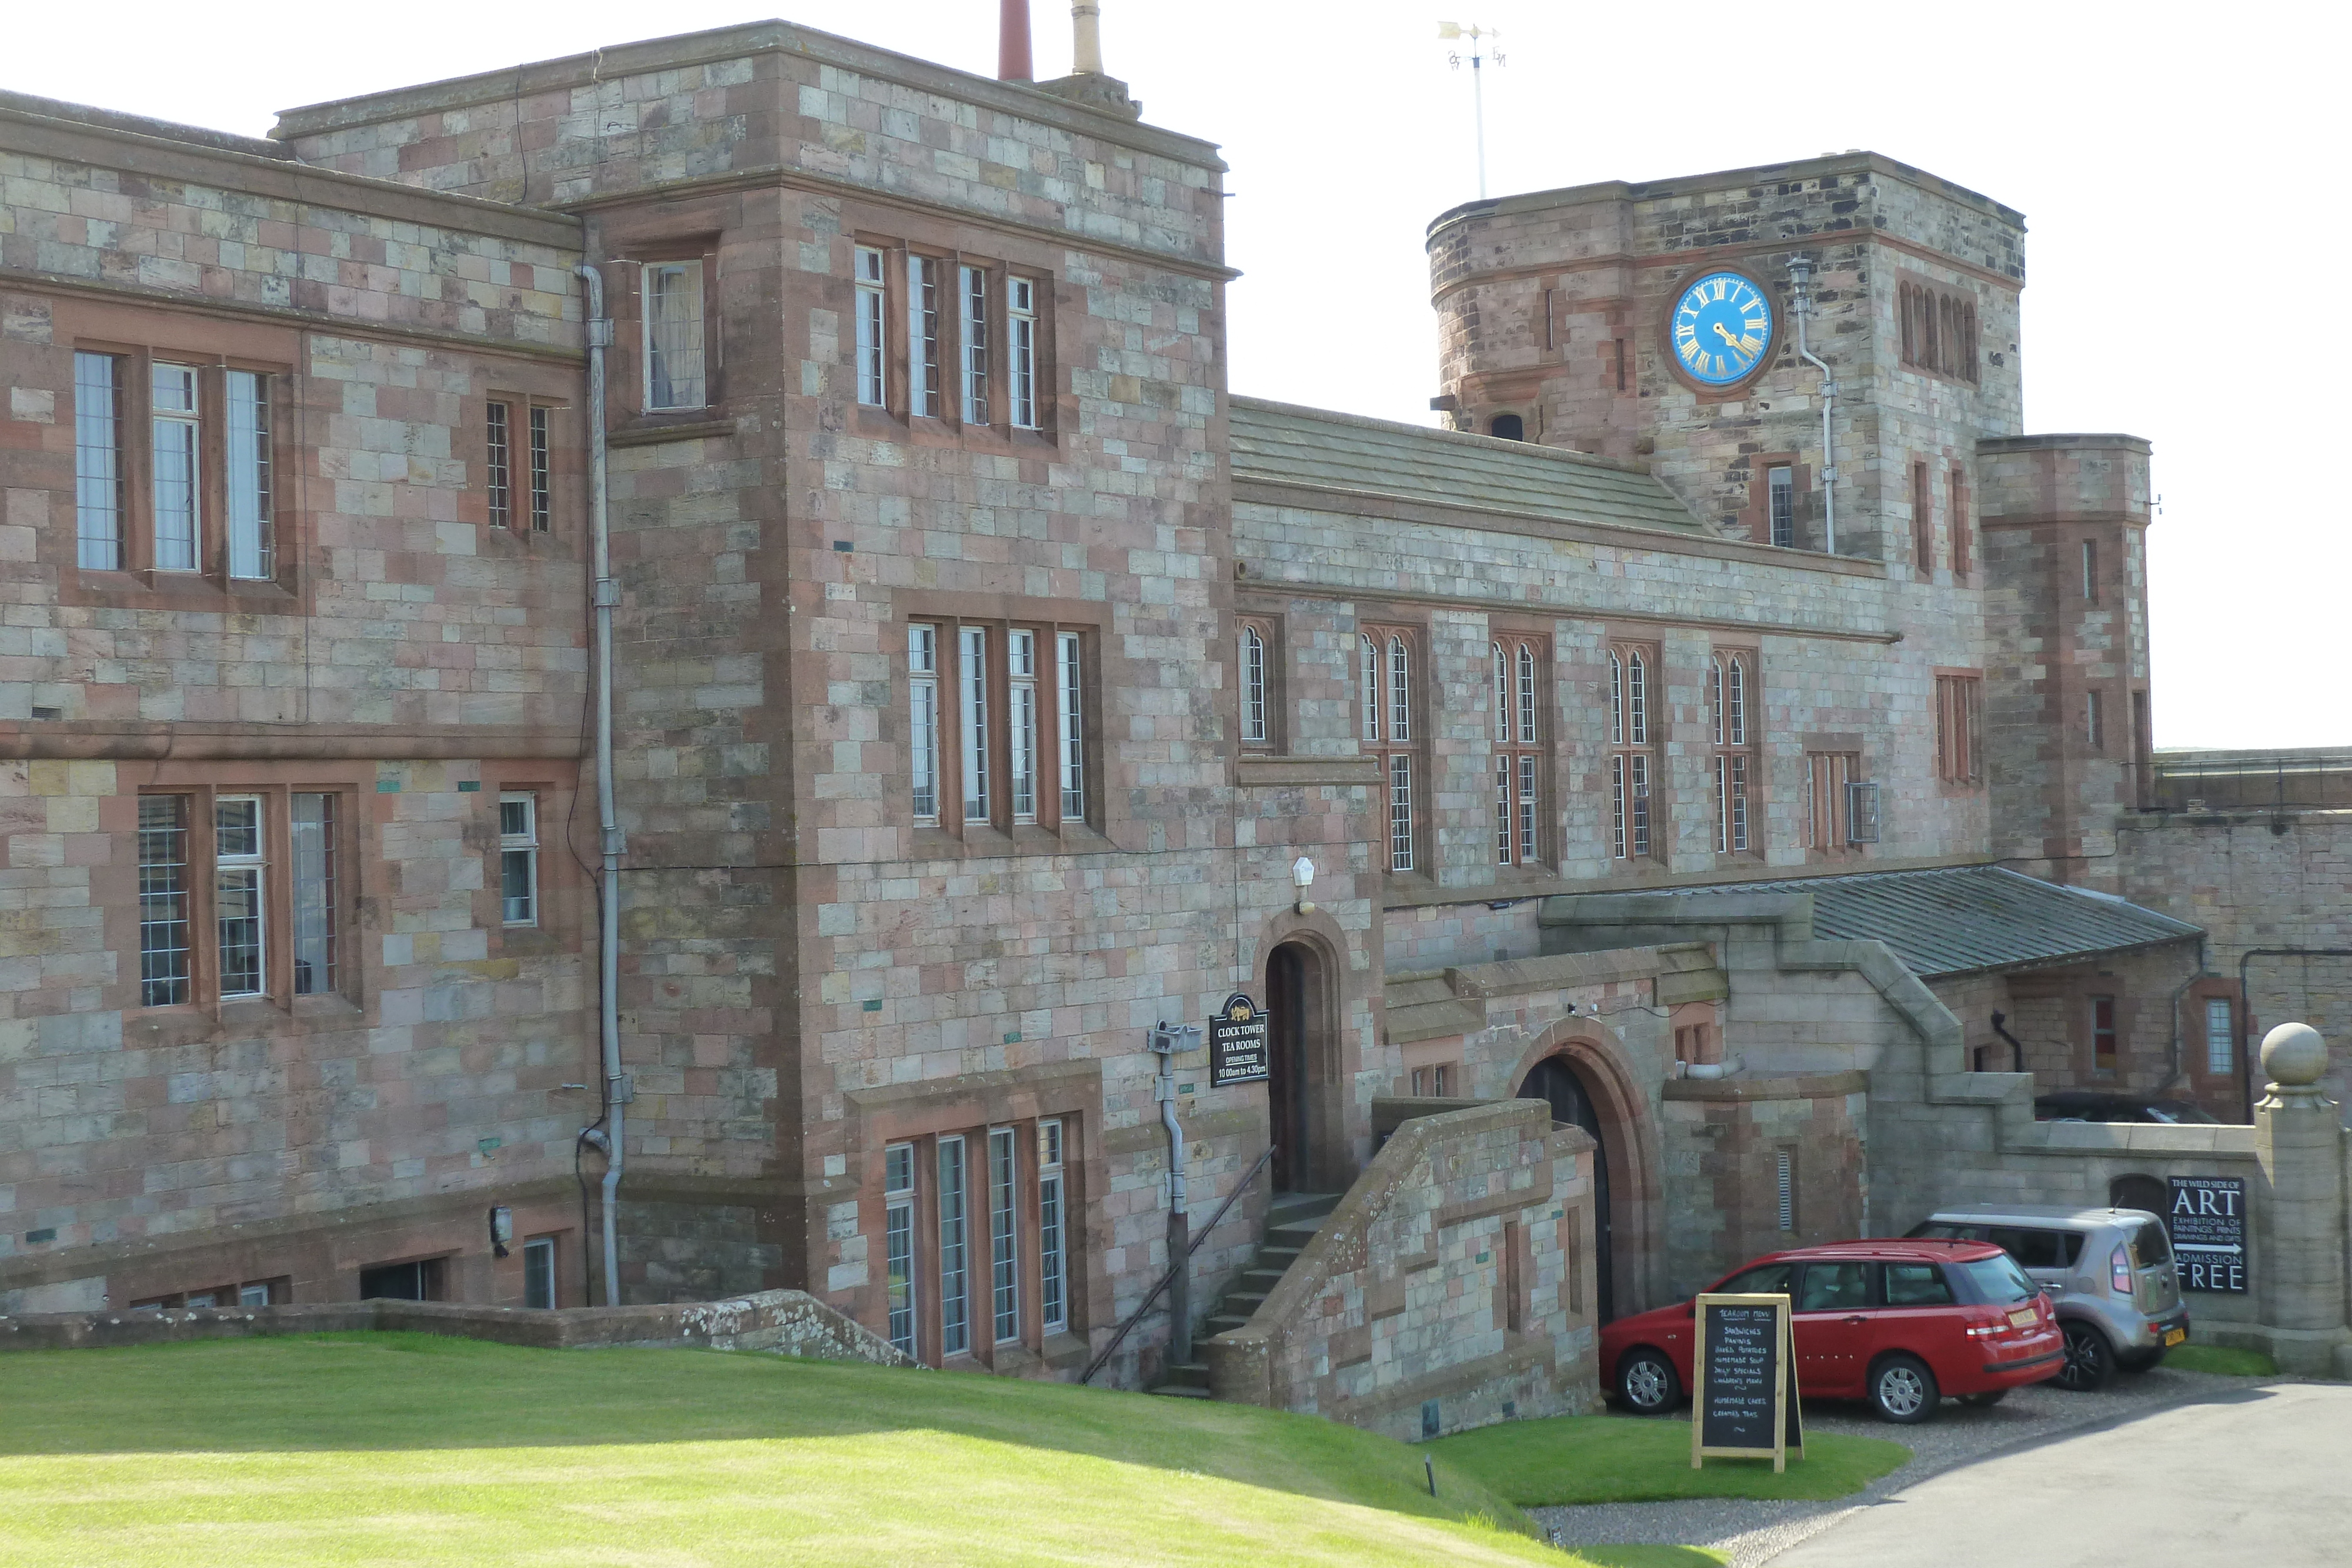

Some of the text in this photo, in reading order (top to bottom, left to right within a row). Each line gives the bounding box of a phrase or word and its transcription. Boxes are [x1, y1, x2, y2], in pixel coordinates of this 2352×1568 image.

[1712, 281, 1726, 300] XII
[1739, 297, 1760, 314] II
[1681, 304, 1699, 319] X
[1678, 323, 1695, 336] IX
[1745, 319, 1763, 330] III
[1218, 1024, 1265, 1038] CLOCK TOWER
[1222, 1039, 1261, 1052] TEA ROOMS
[1225, 1055, 1244, 1064] OPENING
[1240, 1067, 1246, 1075] to
[1247, 1065, 1266, 1075] 4.30pm
[2171, 1179, 2188, 1188] THE
[2189, 1179, 2210, 1188] WILD
[2228, 1181, 2239, 1189] OF
[2171, 1188, 2241, 1216] ART
[2173, 1216, 2224, 1226] EXHIBITION
[2216, 1226, 2241, 1235] PRINTS
[2176, 1253, 2241, 1265] ADMISSION
[1719, 1309, 1749, 1318] TEAROOM
[1724, 1327, 1762, 1335] SANDWICHES
[1724, 1337, 1752, 1345] PANINIS
[1738, 1346, 1767, 1354] POTATOES
[1714, 1366, 1730, 1376] DAILY
